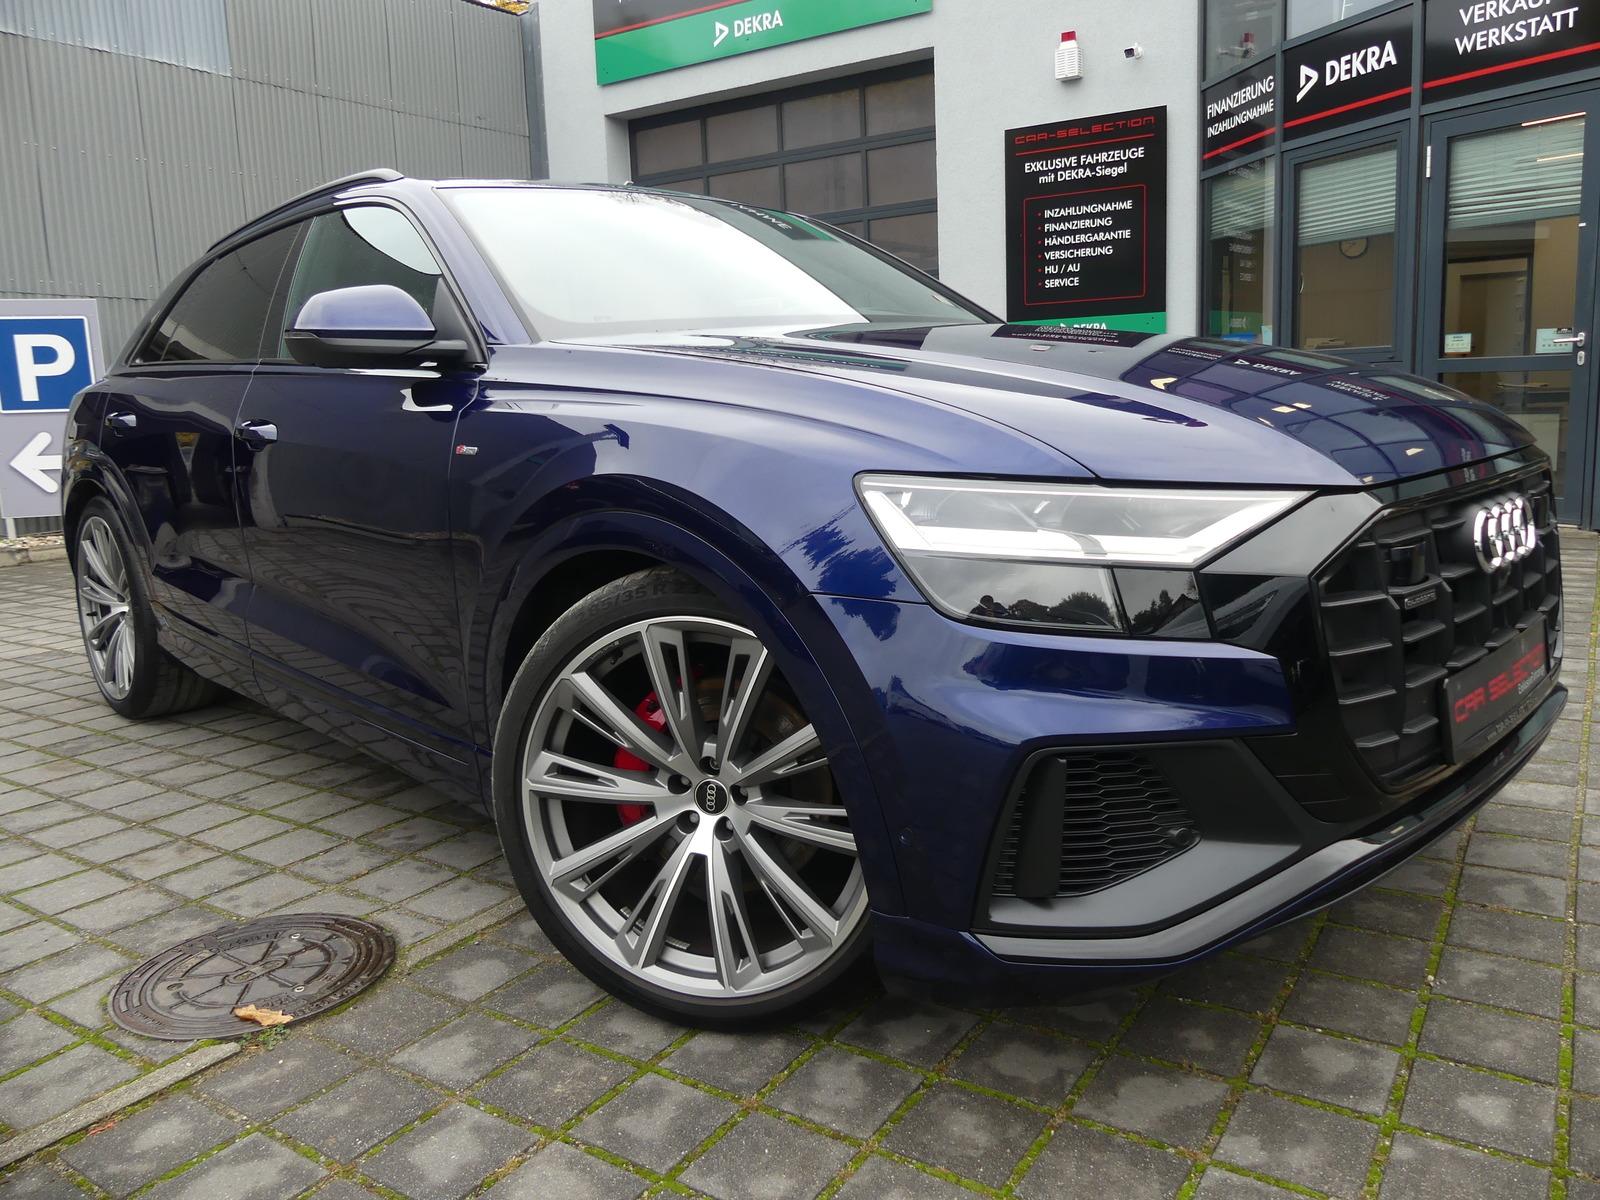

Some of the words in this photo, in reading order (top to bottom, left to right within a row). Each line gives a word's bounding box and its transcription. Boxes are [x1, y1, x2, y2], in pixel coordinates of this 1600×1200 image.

[734, 10, 783, 38] DEKRA
[1454, 7, 1579, 55] WERKSTATT
[1325, 40, 1397, 86] DEKRA
[1207, 75, 1274, 120] FINANZIERUNG
[1014, 116, 1155, 145] CAR-SELECTION
[1207, 98, 1274, 138] INZAHLUNGNAHME
[1024, 156, 1078, 173] EXKLUSIVE
[1080, 147, 1145, 166] FAHRZEUGE
[1038, 173, 1055, 184] mit
[1057, 162, 1127, 181] DEKRA-Siegel
[1044, 200, 1133, 219] INZAHLUNGNAHME
[1044, 217, 1113, 232] FINANZIERUNG
[1044, 229, 1131, 247] HÄNDLERGARANTIE
[1044, 246, 1113, 261] VERSICHERUNG
[1044, 265, 1059, 275] HU
[1066, 263, 1081, 272] AU
[1044, 277, 1080, 288] SERVICE
[13, 334, 75, 402] P
